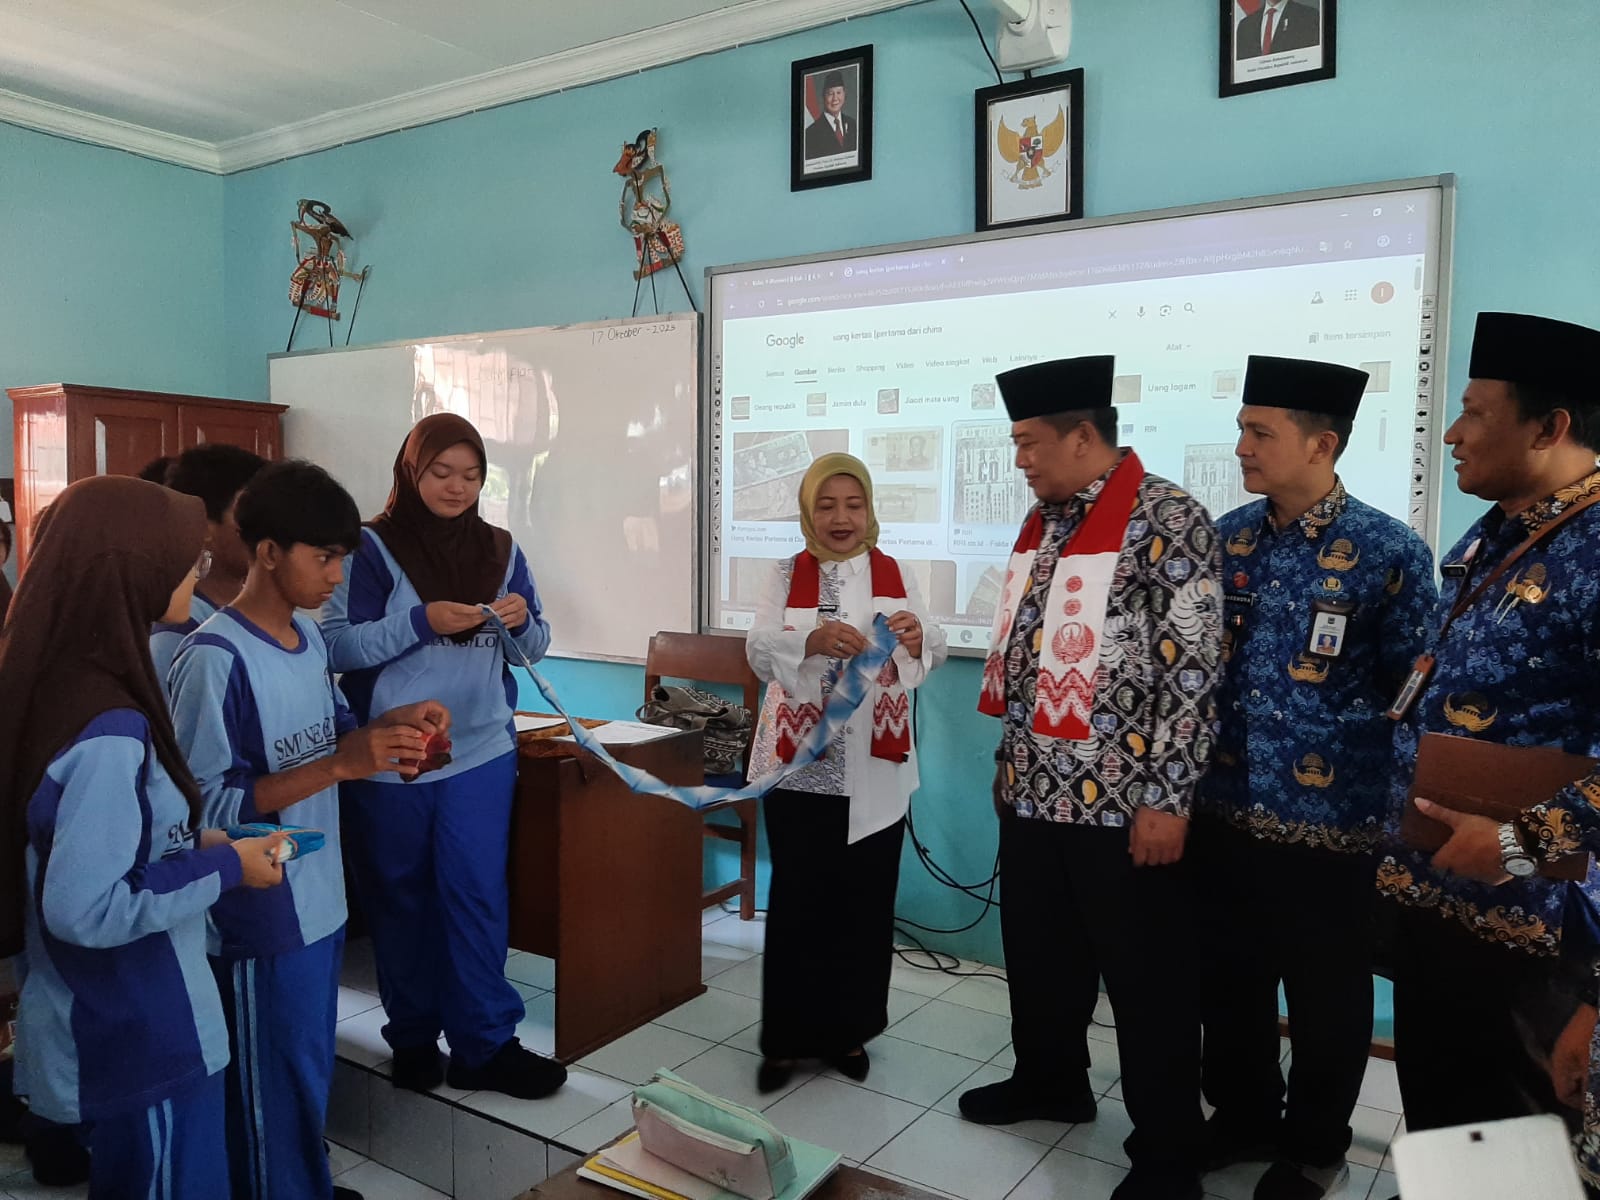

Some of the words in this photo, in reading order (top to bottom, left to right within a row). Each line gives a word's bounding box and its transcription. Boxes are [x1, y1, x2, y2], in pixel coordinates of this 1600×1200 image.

[907, 327, 922, 336] dari
[922, 325, 943, 335] china
[592, 331, 604, 345] 17
[766, 332, 805, 349] Google
[1166, 343, 1183, 351] Alat
[925, 359, 944, 368] Video
[945, 357, 970, 367] singkat
[982, 355, 998, 364] Web
[1009, 353, 1038, 364] Lainnya
[827, 365, 846, 375] Berita
[856, 363, 886, 374] Shopping
[895, 361, 914, 370] Video
[794, 367, 817, 377] Gambar
[1147, 383, 1173, 393] Uang
[1175, 381, 1197, 393] logam
[764, 535, 787, 543] Pertama
